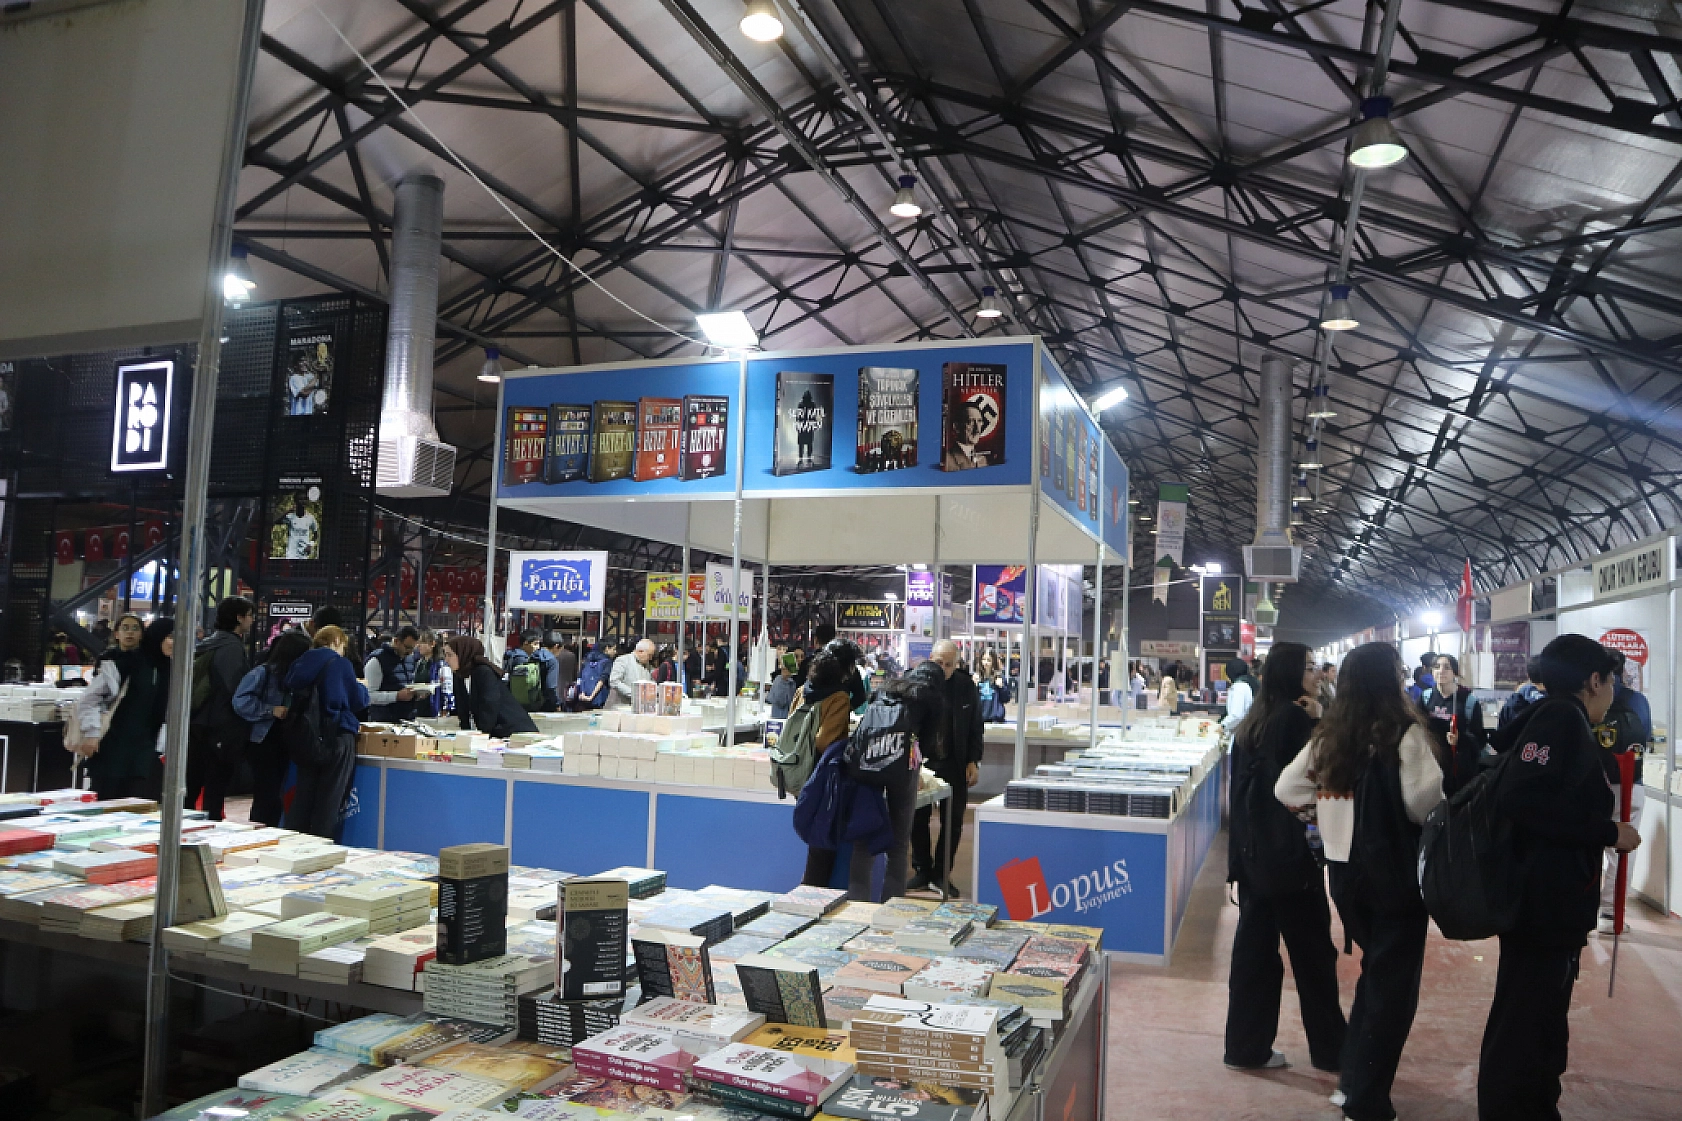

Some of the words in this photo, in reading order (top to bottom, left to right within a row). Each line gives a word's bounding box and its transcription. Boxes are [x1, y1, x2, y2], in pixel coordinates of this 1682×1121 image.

[866, 732, 905, 759] NIKE
[1521, 742, 1550, 765] 84
[1025, 858, 1129, 919] Lopus
